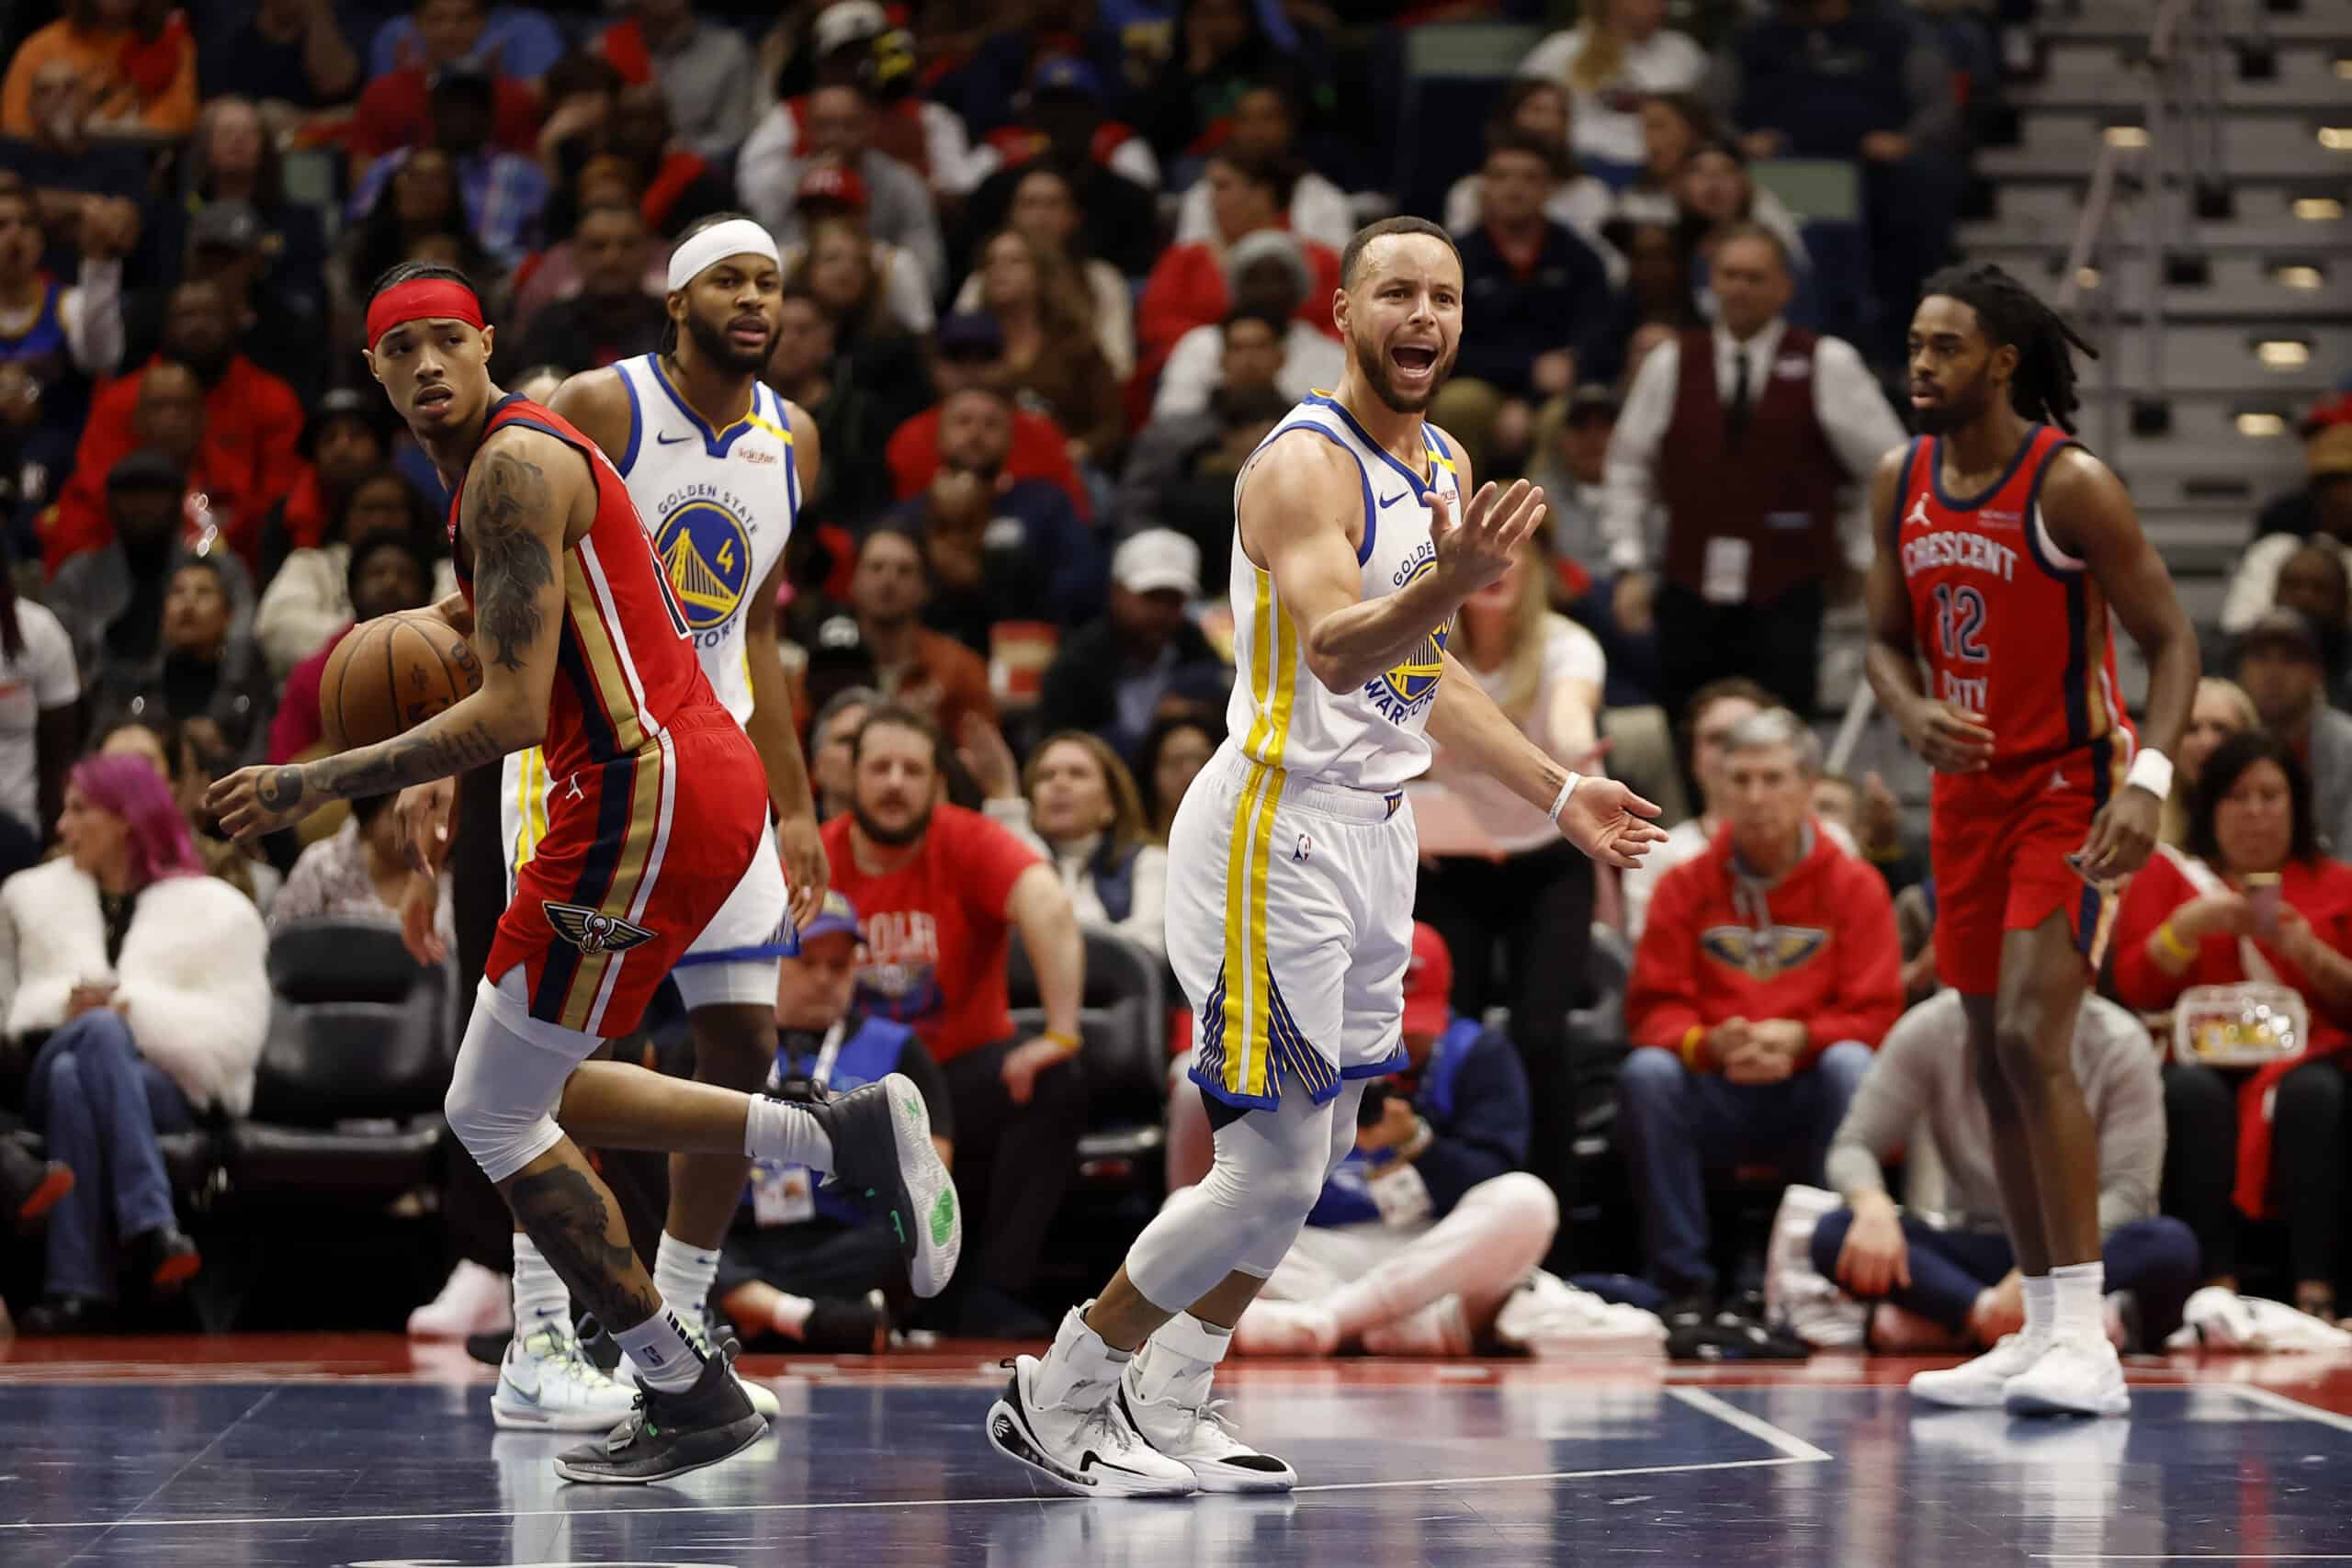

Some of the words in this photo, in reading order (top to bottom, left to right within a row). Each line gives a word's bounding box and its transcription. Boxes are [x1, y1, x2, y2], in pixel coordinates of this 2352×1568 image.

[658, 484, 716, 514] GOLDEN
[724, 491, 758, 535] STATE
[716, 537, 734, 574] 4
[1393, 541, 1434, 586] GOLDE
[1903, 530, 2018, 583] CRESCENT
[1933, 582, 1989, 661] 12
